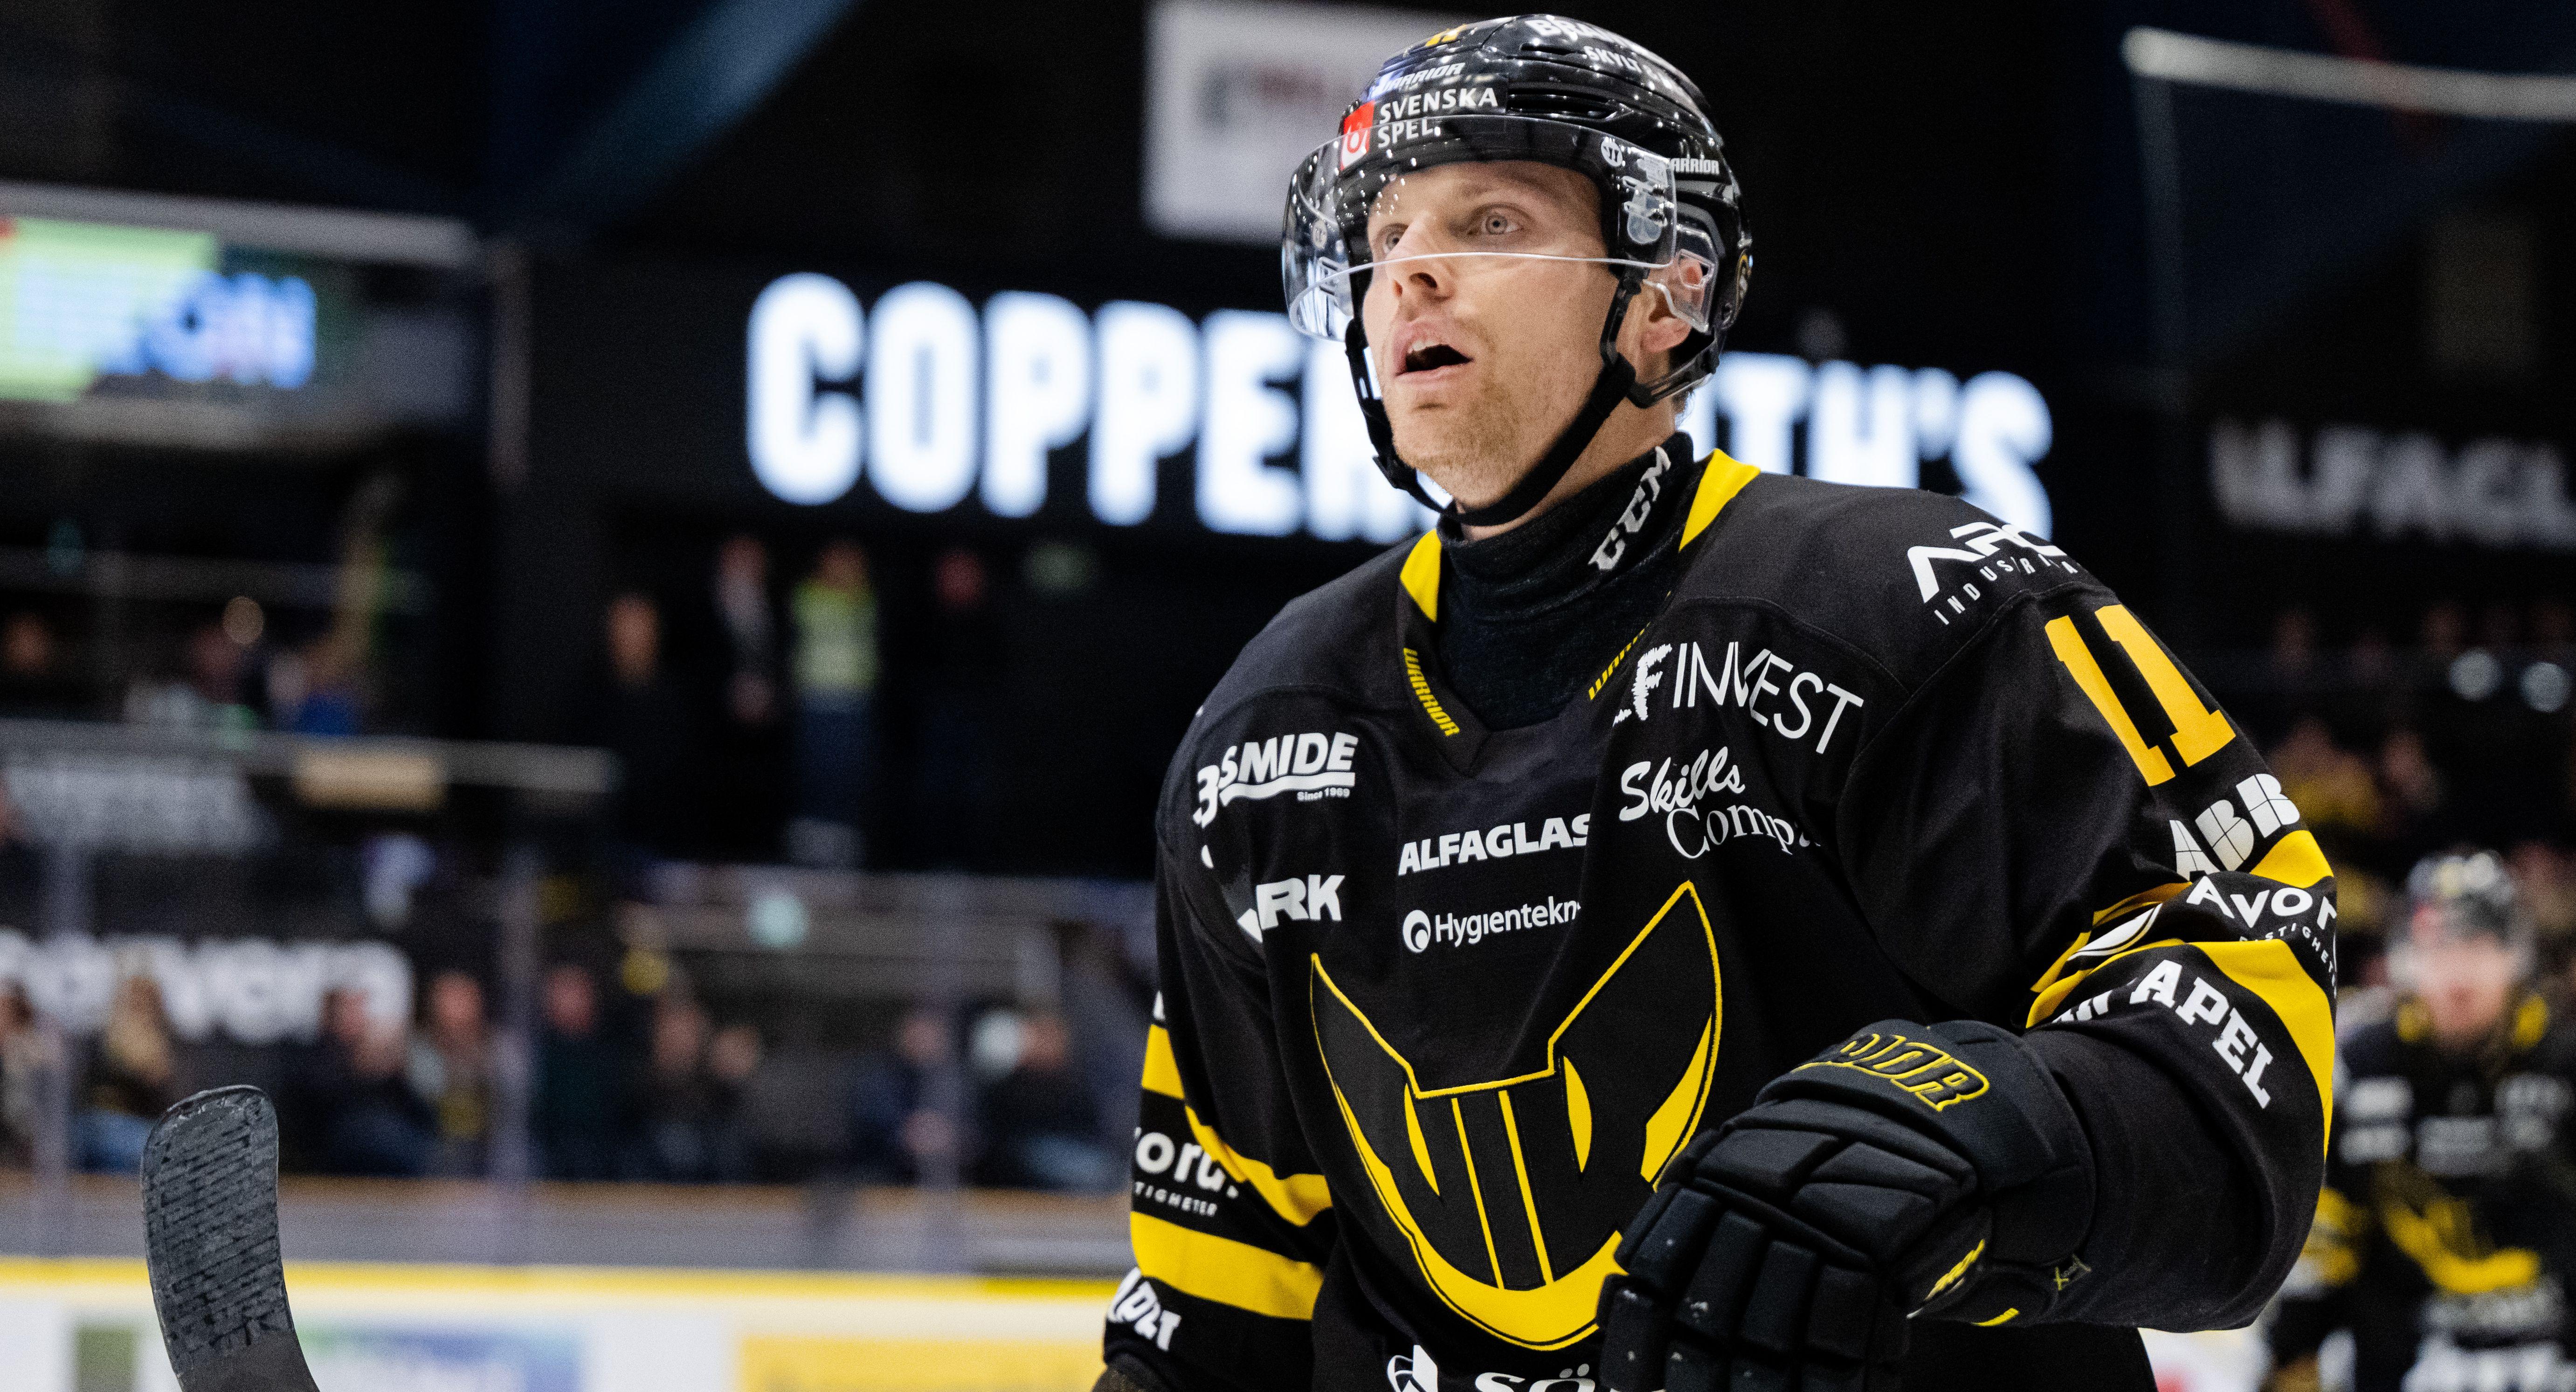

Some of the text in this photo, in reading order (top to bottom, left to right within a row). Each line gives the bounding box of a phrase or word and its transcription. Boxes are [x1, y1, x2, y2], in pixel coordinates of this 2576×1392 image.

[1377, 118, 1434, 148] SPEL
[1379, 87, 1499, 125] SVENSKA
[1587, 446, 1671, 570] CCM
[2044, 604, 2236, 787] 11
[1619, 747, 1746, 822] Skills
[1666, 804, 1809, 859] Comp
[2169, 773, 2300, 881] ABB
[1435, 895, 1582, 948] Hygientekn
[2129, 959, 2274, 1109] APEL
